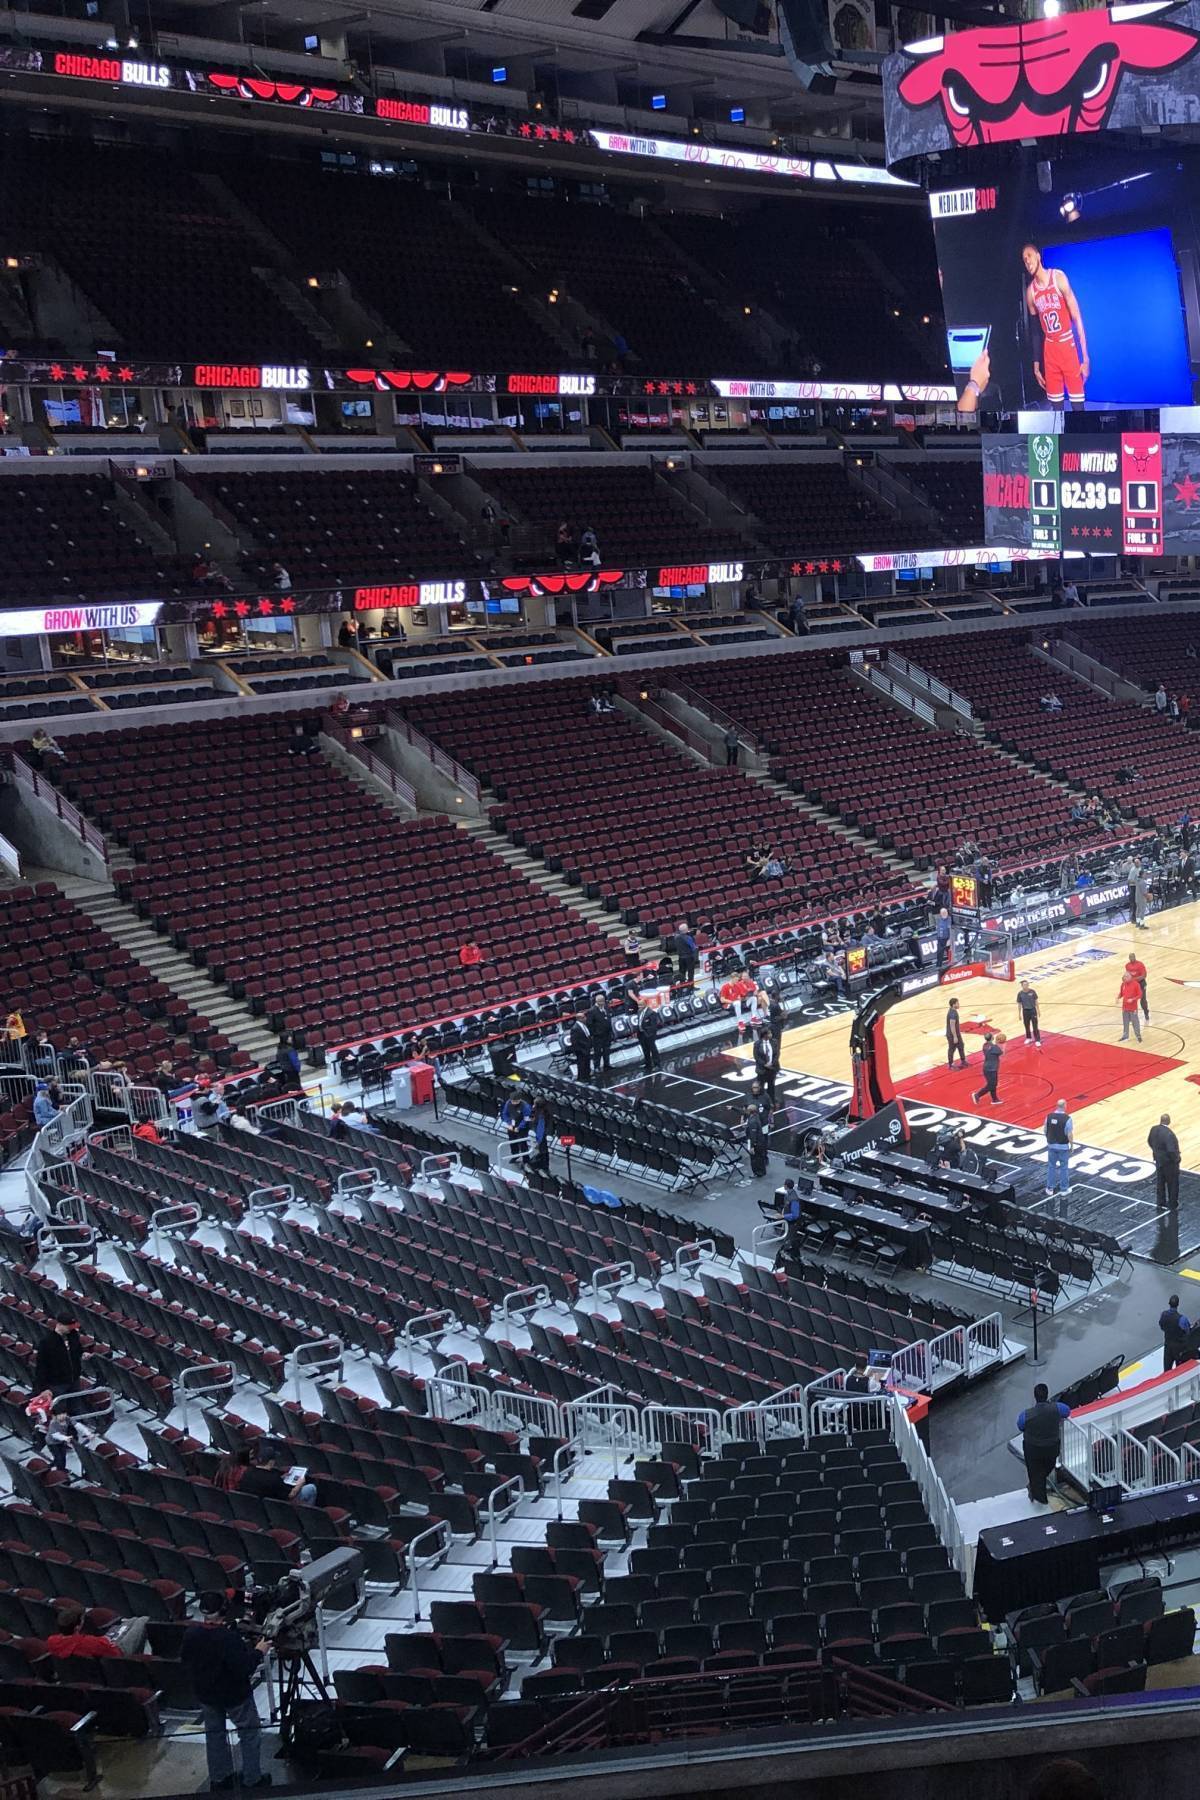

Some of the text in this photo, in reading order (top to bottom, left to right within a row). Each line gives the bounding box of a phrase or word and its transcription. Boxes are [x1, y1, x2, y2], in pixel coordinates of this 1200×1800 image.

[55, 53, 170, 88] CHICAGO BULLS
[376, 98, 468, 129] CHICAGO BULLS
[609, 136, 656, 154] GROW WITH US
[938, 193, 958, 214] MEDIA
[961, 191, 974, 211] DAY
[1044, 311, 1062, 333] 12
[195, 365, 310, 389] CHICAGO BULLS
[508, 375, 595, 395] CHICAGO BULLS
[730, 382, 775, 396] GROW WITH US
[1062, 452, 1118, 472] RUN WITH US
[1061, 482, 1106, 509] 62:33
[873, 554, 918, 570] GROW WITH US
[659, 564, 743, 587] CHICAGO BULLS
[355, 582, 465, 610] CHICAGO BULLS
[44, 605, 137, 630] GROW WITH US
[956, 889, 974, 906] 24
[615, 1020, 625, 1032] G
[905, 1107, 1158, 1182] CHCAGO
